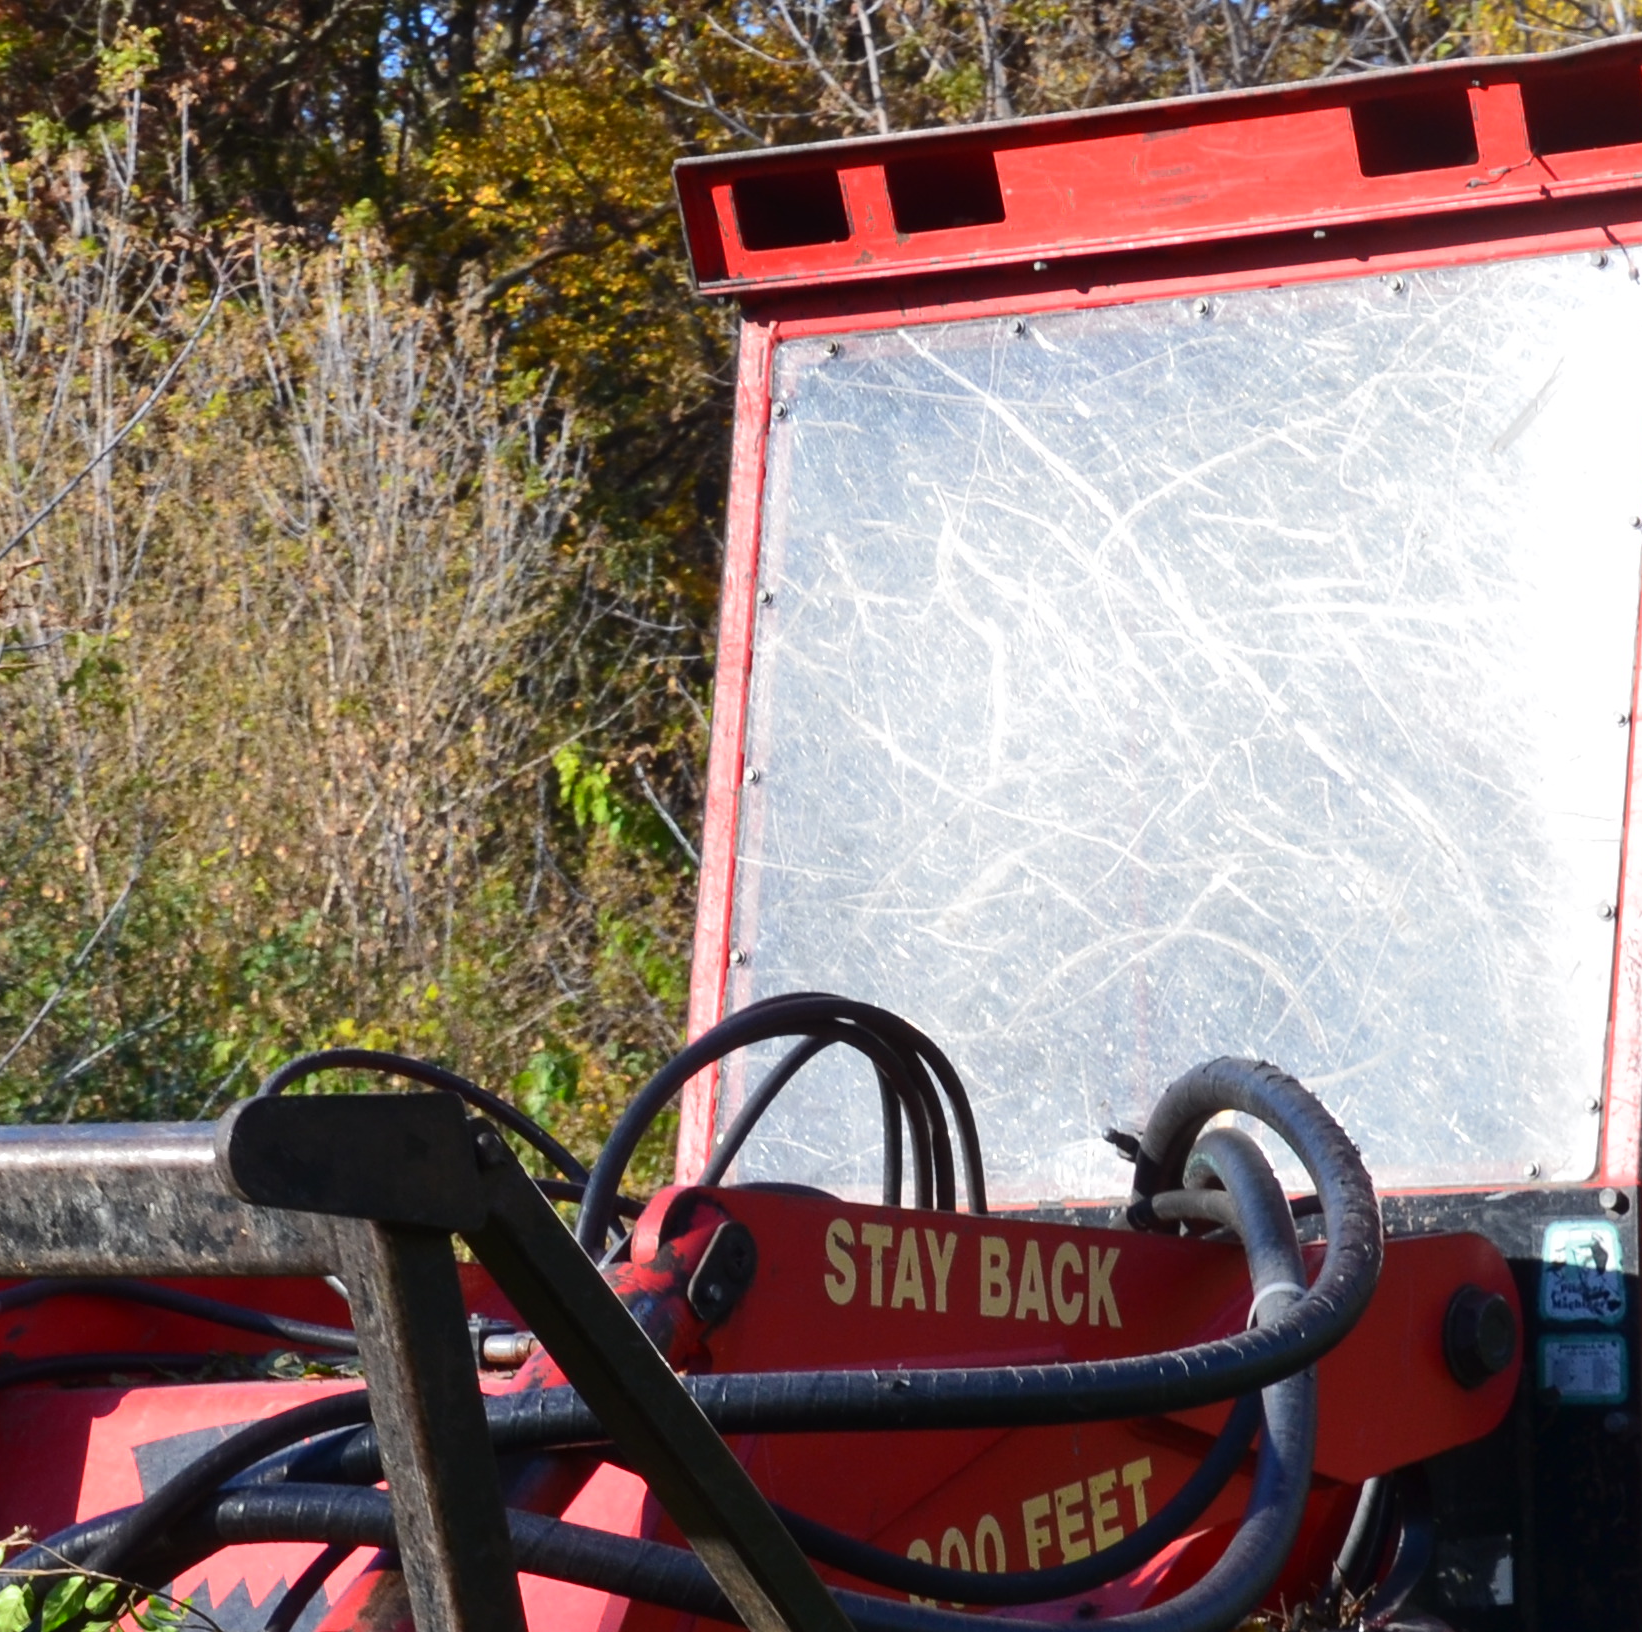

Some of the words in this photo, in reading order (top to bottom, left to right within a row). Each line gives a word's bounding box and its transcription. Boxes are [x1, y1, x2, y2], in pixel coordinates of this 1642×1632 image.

[824, 1218, 958, 1313] STAY
[979, 1235, 1123, 1329] BACK
[1021, 1455, 1153, 1572] FEET
